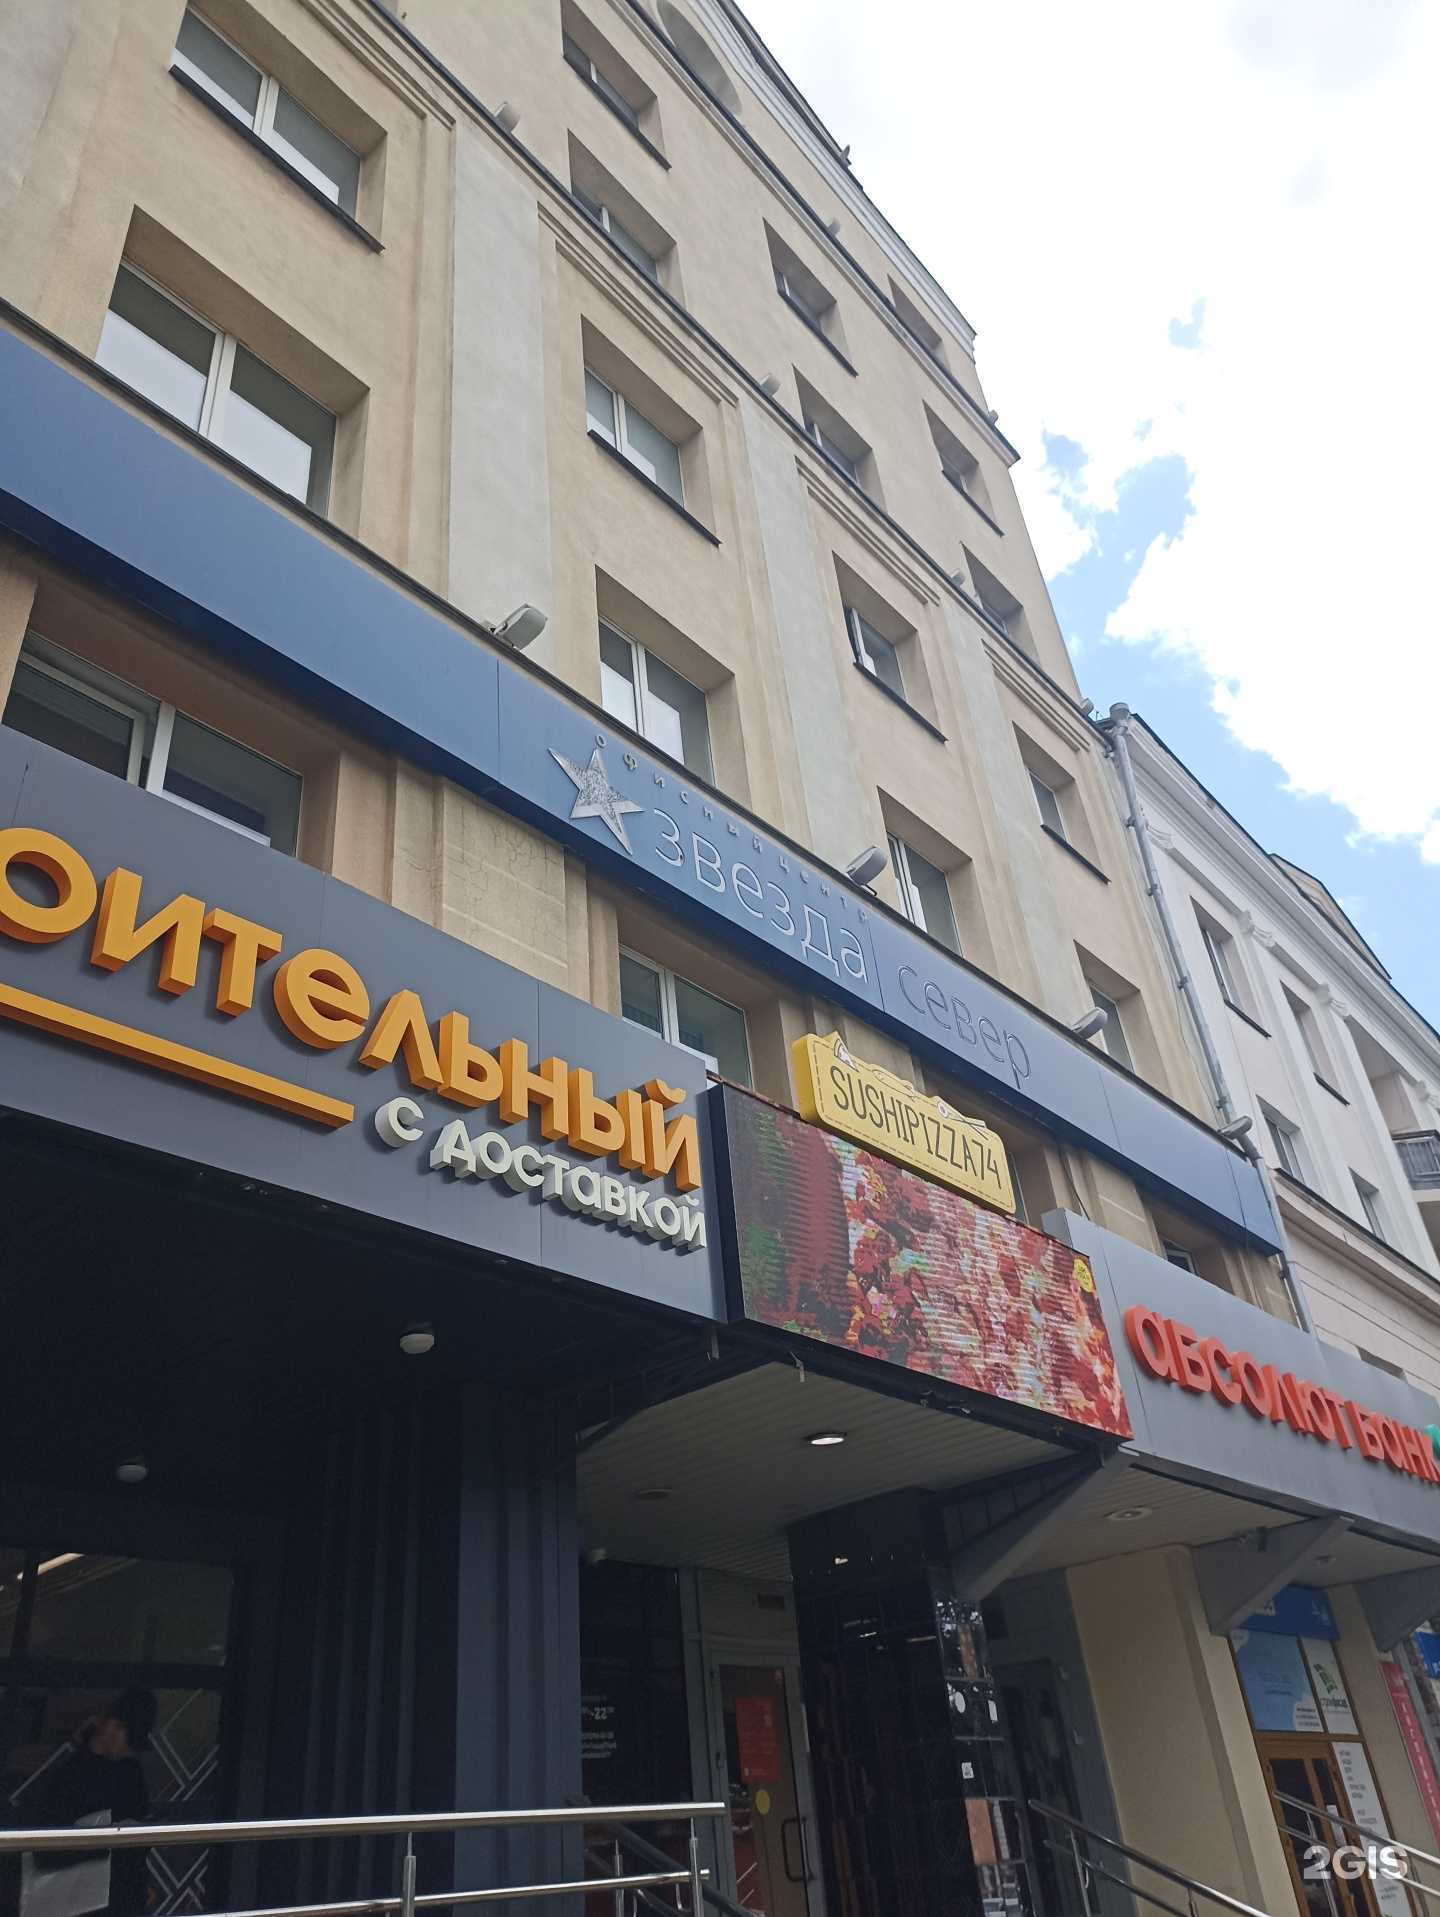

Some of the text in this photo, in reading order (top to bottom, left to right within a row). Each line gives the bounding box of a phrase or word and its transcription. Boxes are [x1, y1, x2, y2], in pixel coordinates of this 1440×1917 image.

[897, 964, 1031, 1090] север
[430, 1119, 707, 1252] доставкой
[830, 1064, 1003, 1190] SUSHIPIZZA74
